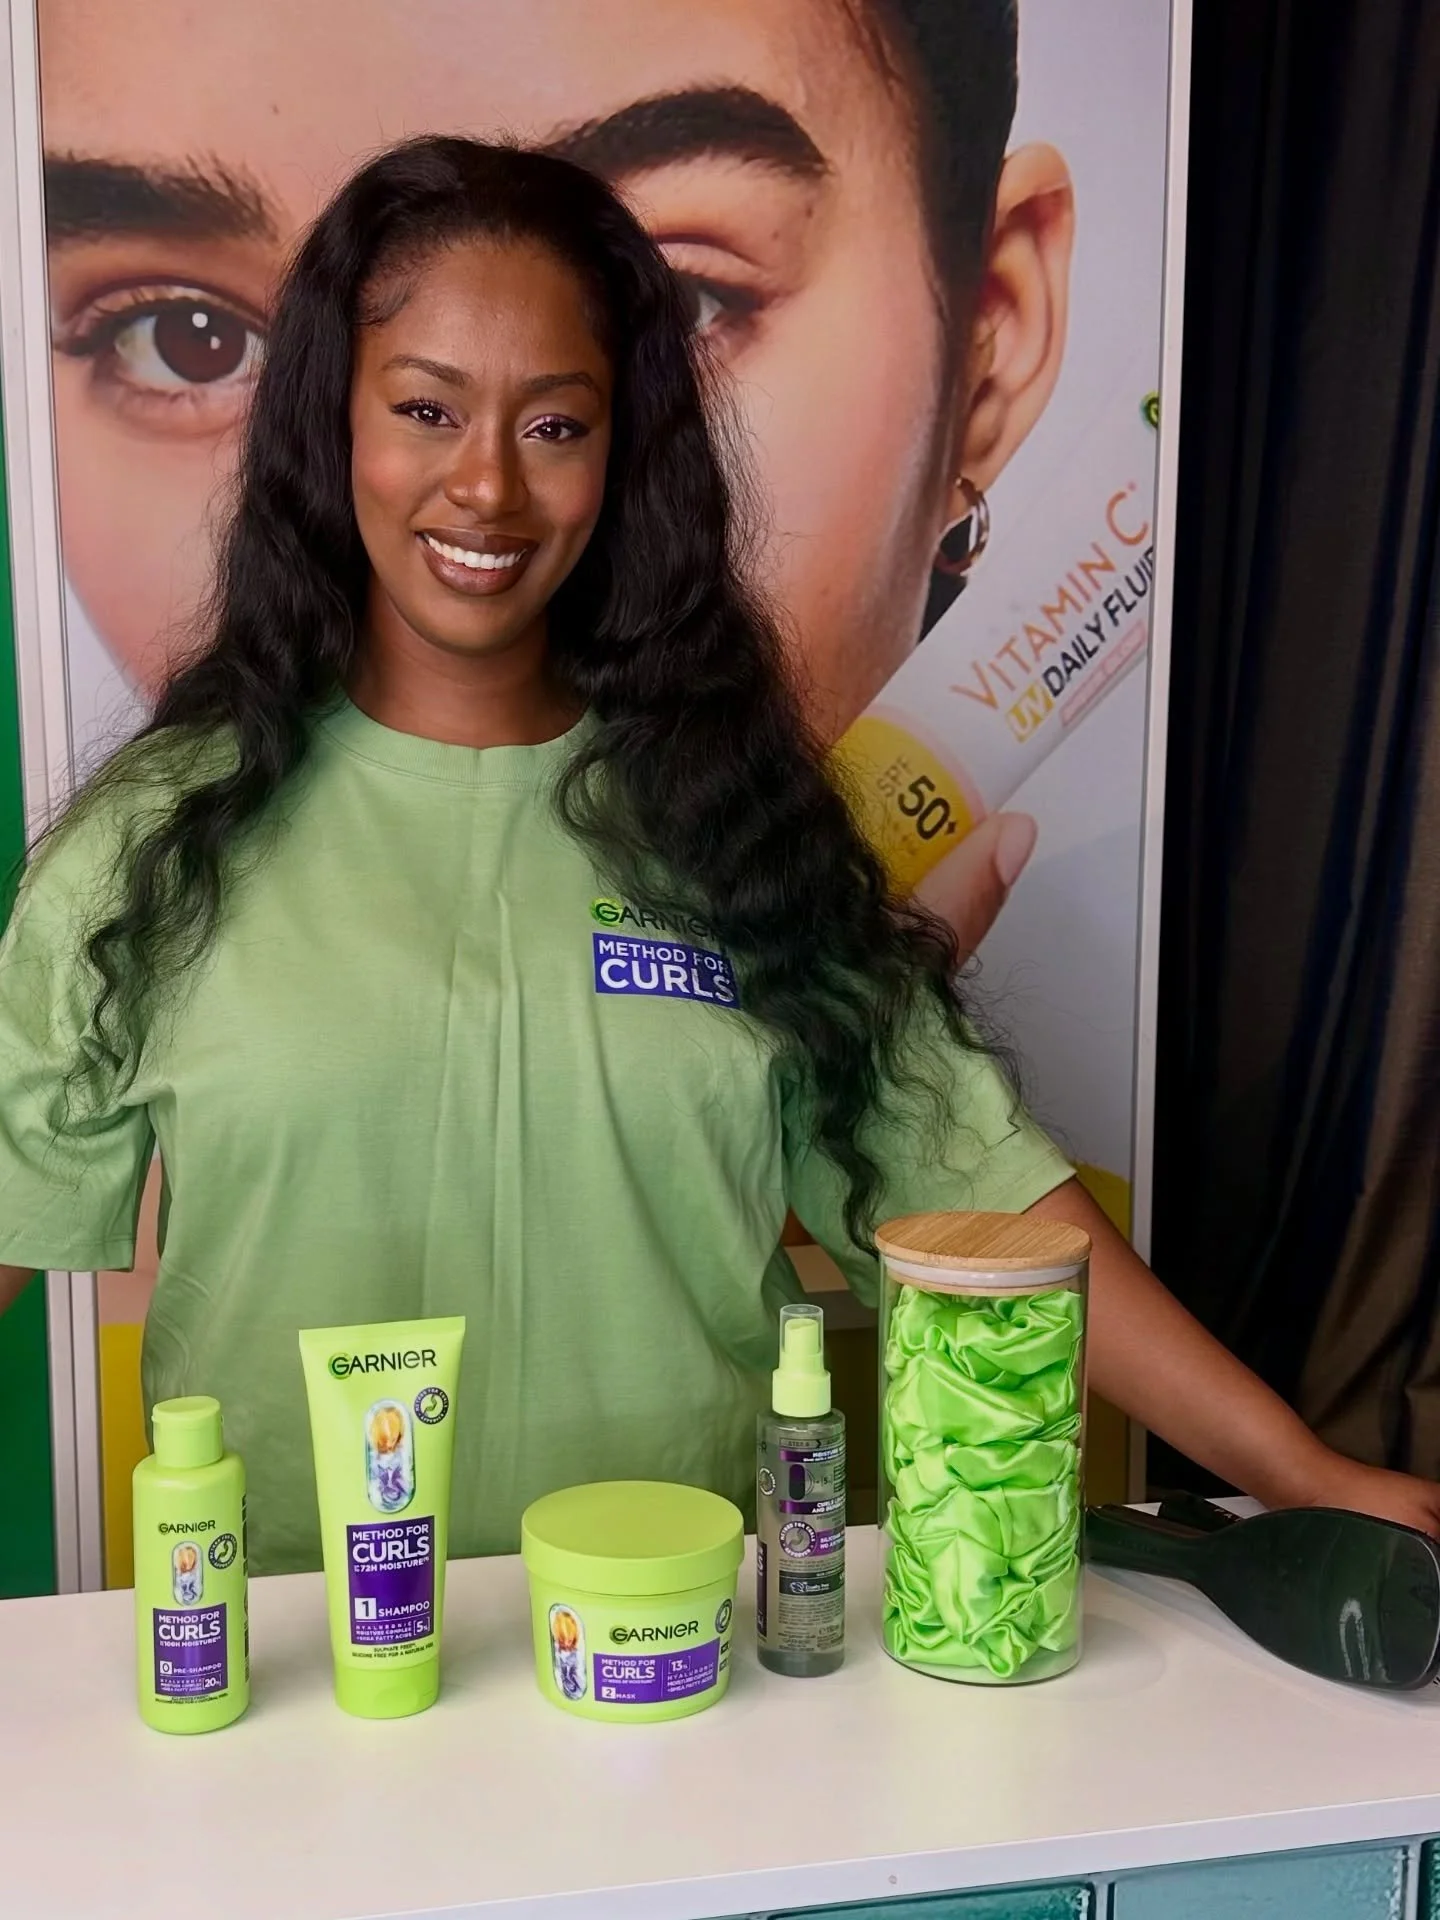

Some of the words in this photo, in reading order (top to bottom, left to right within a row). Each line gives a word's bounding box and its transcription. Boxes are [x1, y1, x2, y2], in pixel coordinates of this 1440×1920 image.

[950, 541, 1117, 712] VITAMIN
[1042, 612, 1106, 698] DAILY
[598, 939, 687, 963] METHOD
[600, 958, 735, 1003] CURLS
[331, 1348, 437, 1376] GARNIER
[158, 1519, 216, 1534] GARNIER
[352, 1528, 404, 1541] METHOD
[406, 1523, 429, 1537] FOR
[352, 1535, 430, 1564] CURLS
[361, 1563, 377, 1573] 72H
[158, 1614, 199, 1624] METHOD
[200, 1611, 220, 1622] FOR
[361, 1600, 370, 1617] 1
[378, 1600, 430, 1617] SHAMPOO
[158, 1620, 221, 1641] CURLS
[612, 1620, 699, 1642] GARNIER
[601, 1659, 637, 1667] METHOD
[638, 1659, 656, 1667] FOR
[602, 1665, 656, 1680] CURLS
[605, 1688, 613, 1698] 2
